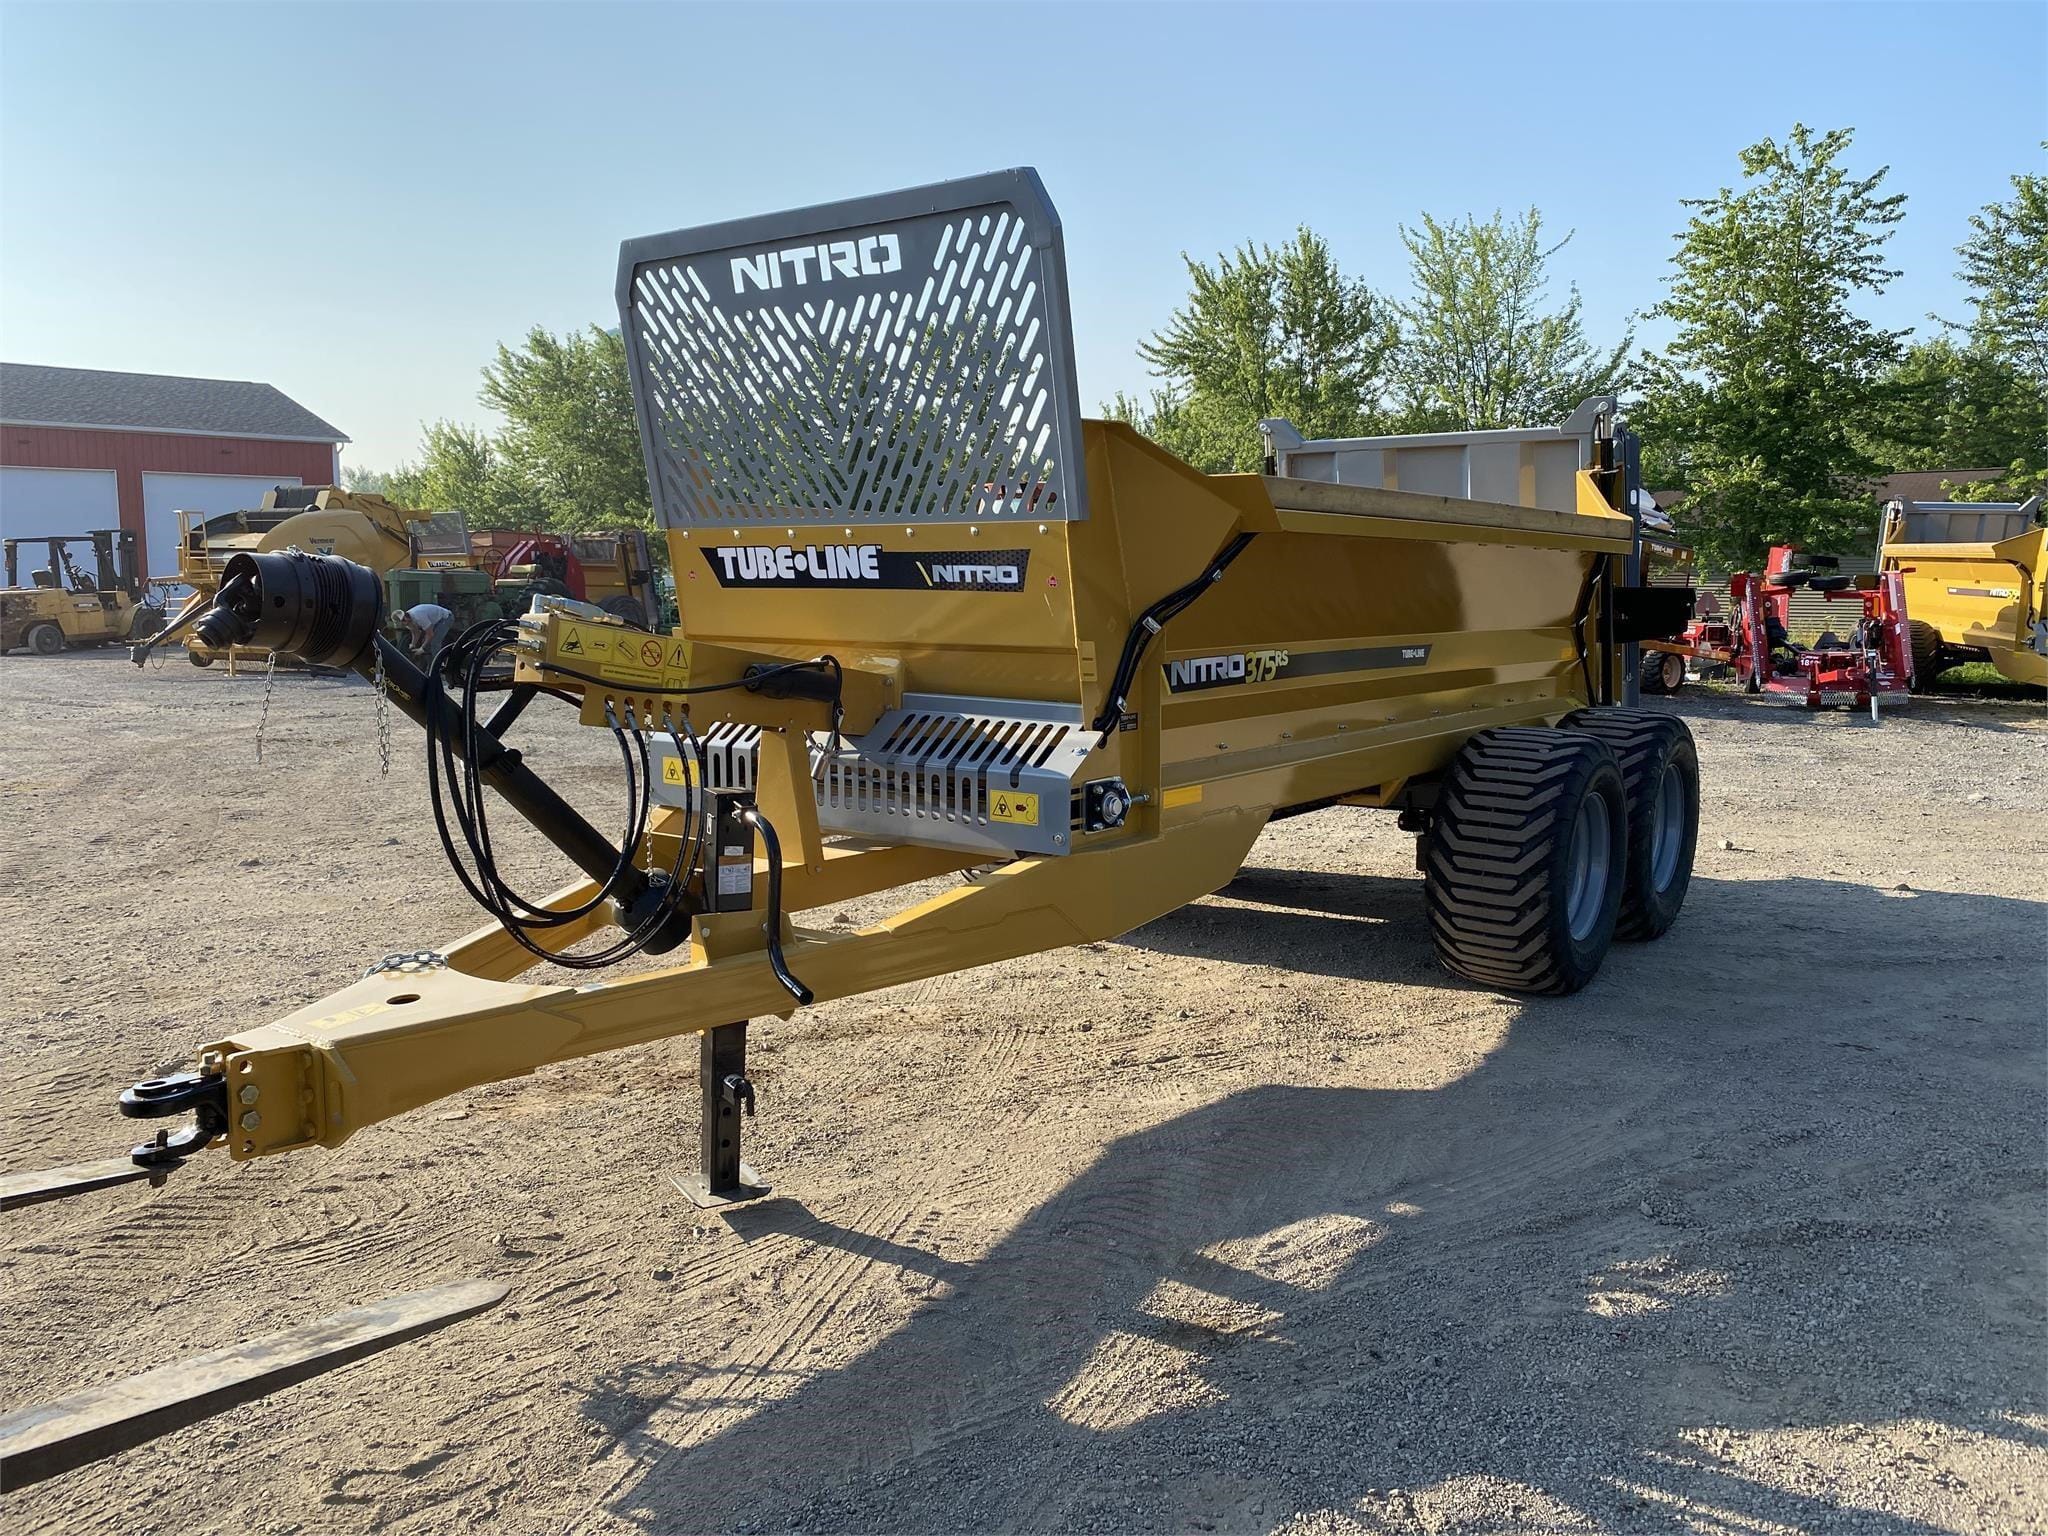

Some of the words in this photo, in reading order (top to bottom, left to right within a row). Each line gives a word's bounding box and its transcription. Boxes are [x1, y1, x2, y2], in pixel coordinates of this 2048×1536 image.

[730, 234, 902, 294] NITRO
[931, 564, 1019, 584] NITRO
[1170, 654, 1245, 687] NITRO
